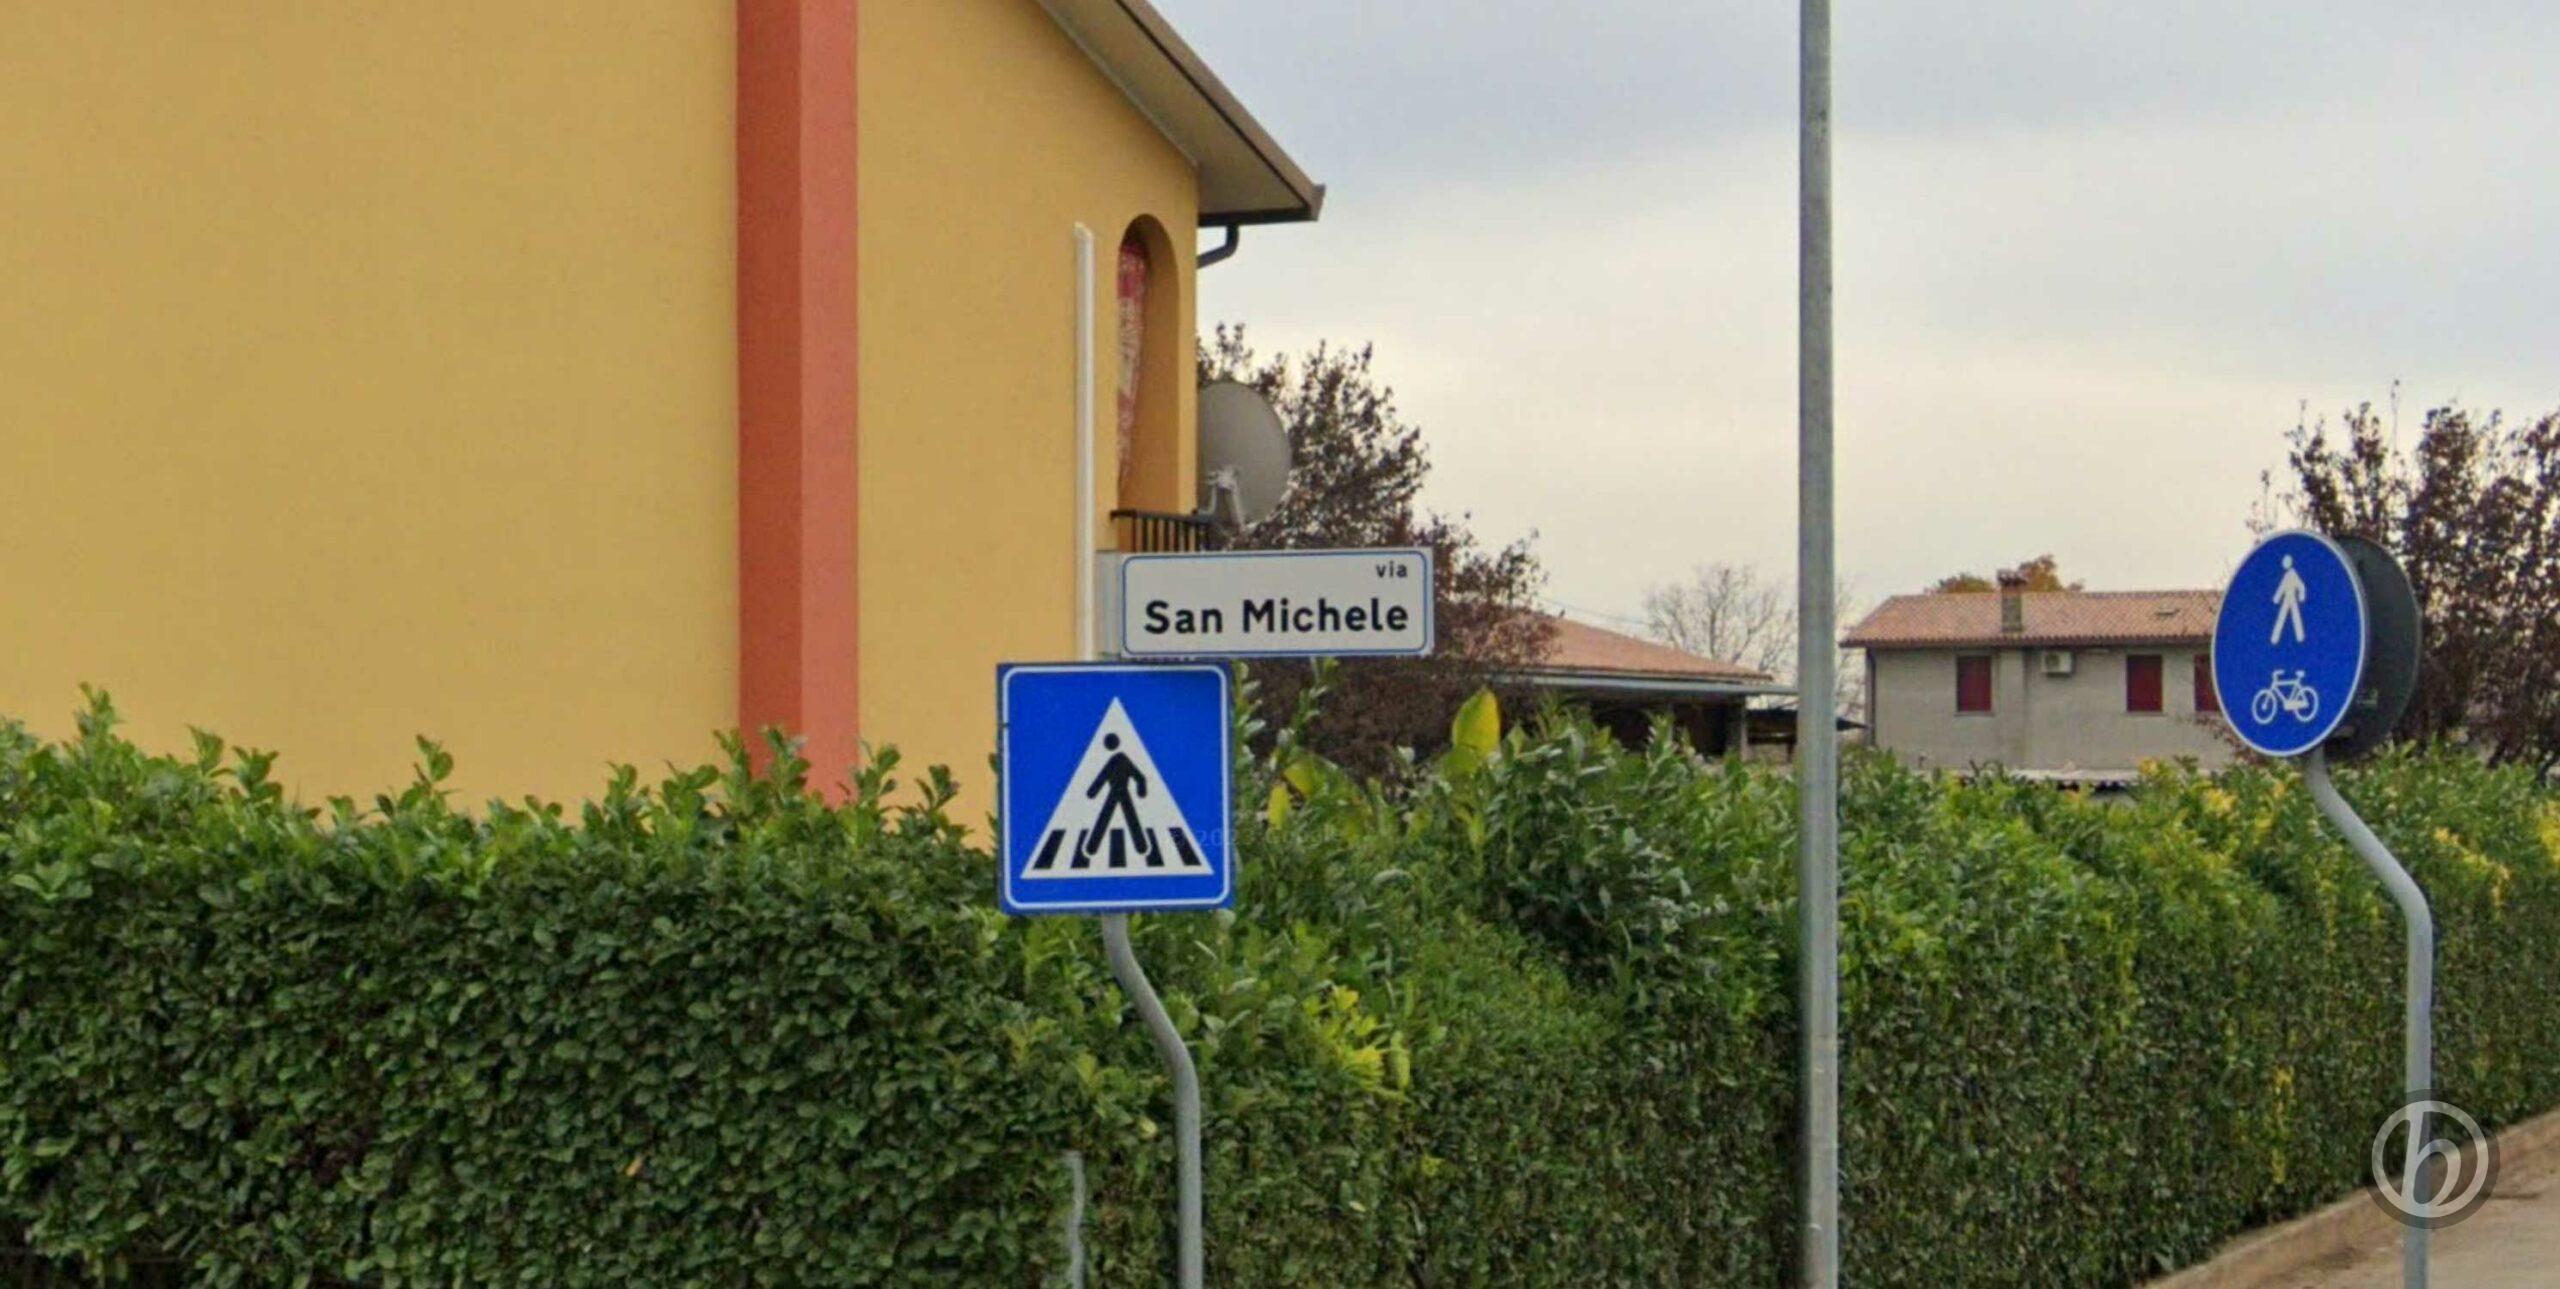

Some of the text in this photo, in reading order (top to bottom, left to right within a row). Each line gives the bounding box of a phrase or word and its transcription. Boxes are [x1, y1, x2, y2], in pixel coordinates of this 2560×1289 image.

[1375, 560, 1408, 578] via
[1144, 598, 1408, 633] San Michele
